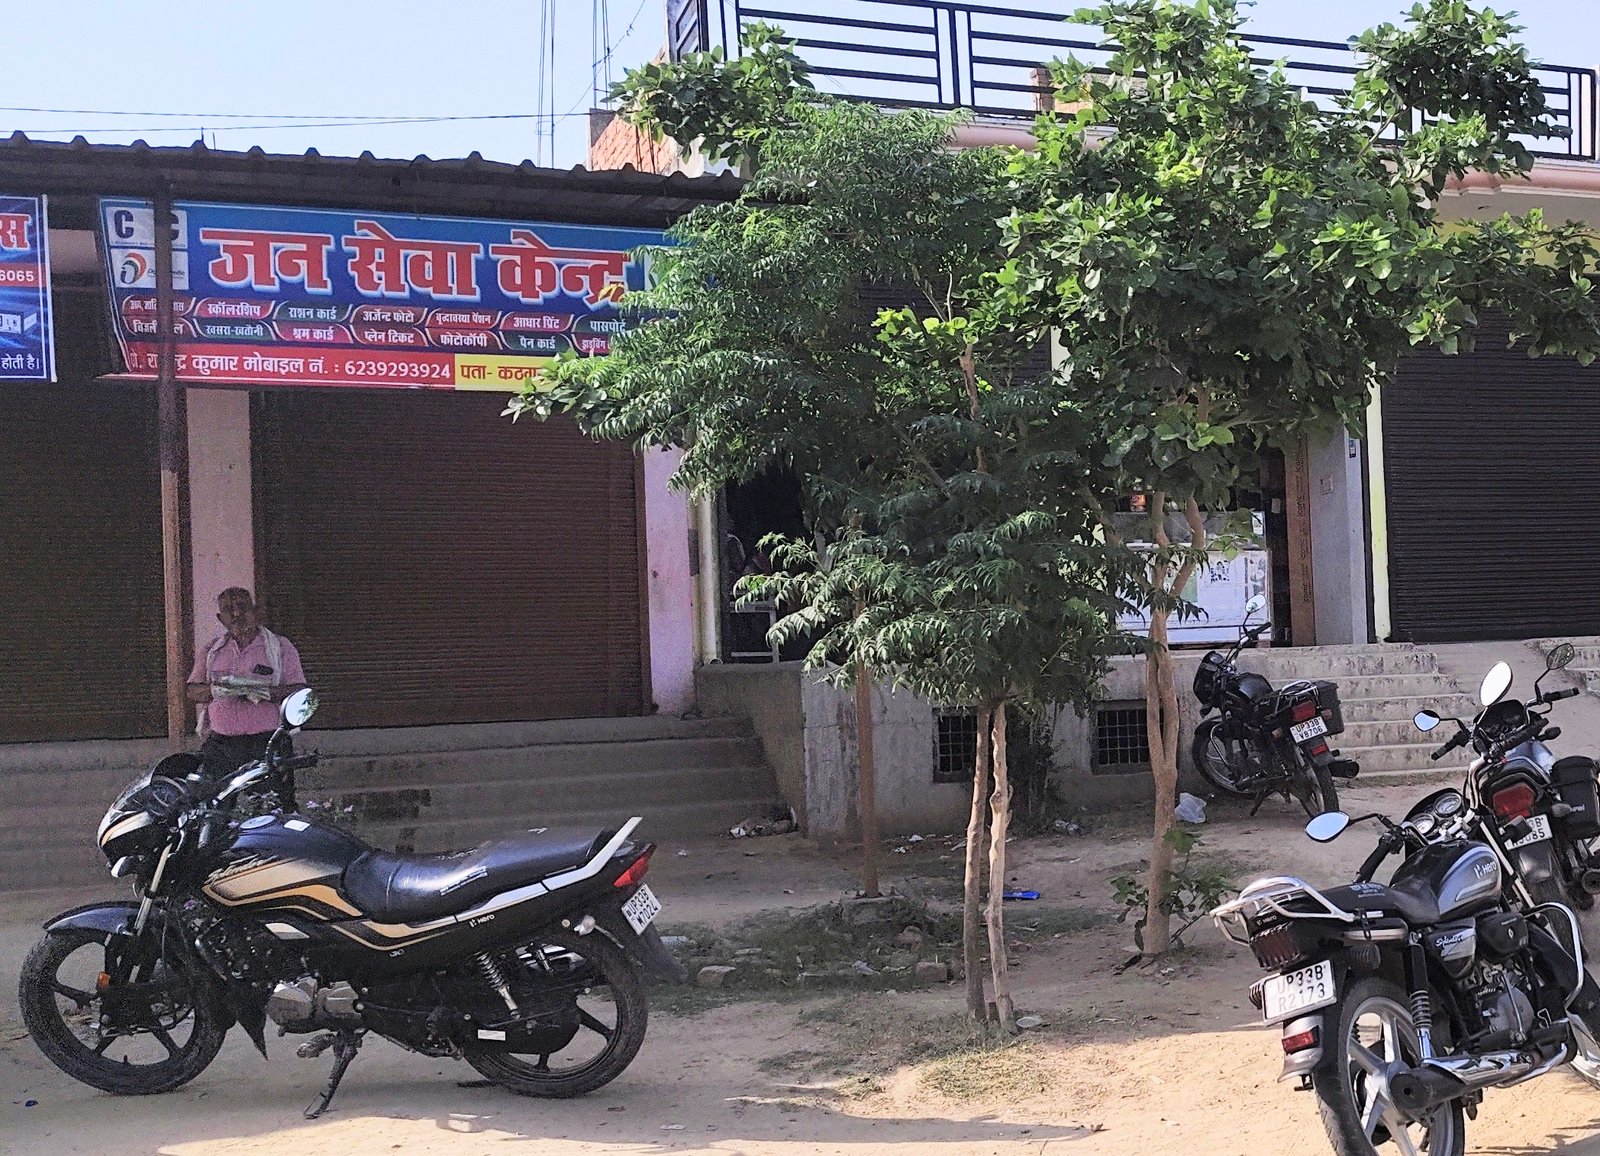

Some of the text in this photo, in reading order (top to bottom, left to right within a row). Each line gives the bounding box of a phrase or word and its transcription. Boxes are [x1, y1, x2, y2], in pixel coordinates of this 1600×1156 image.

[201, 221, 632, 309] जन सेवा केन्द्र
[208, 302, 261, 316] स्कॉलरशिप
[289, 306, 337, 319] राशन कार्ड
[393, 310, 414, 323] फोटो
[514, 316, 560, 329] आधार प्रिंट
[293, 326, 334, 340] श्रम कार्ड
[365, 329, 414, 343] प्लेन टिकट
[440, 332, 487, 347] फोटोकॉपी
[537, 336, 556, 349] कार्ड
[2, 353, 24, 369] होती
[191, 355, 239, 375] कुमार
[243, 352, 304, 375] मोबाइल
[308, 357, 328, 374] नं.
[344, 361, 451, 379] 6239293924
[460, 364, 492, 379] पता-
[1295, 718, 1319, 732] UP33B
[1299, 726, 1323, 739] V8706
[1482, 861, 1497, 874] Hero
[628, 888, 649, 915] UP33B
[477, 914, 495, 925] Hero
[1277, 965, 1323, 994] UP33B
